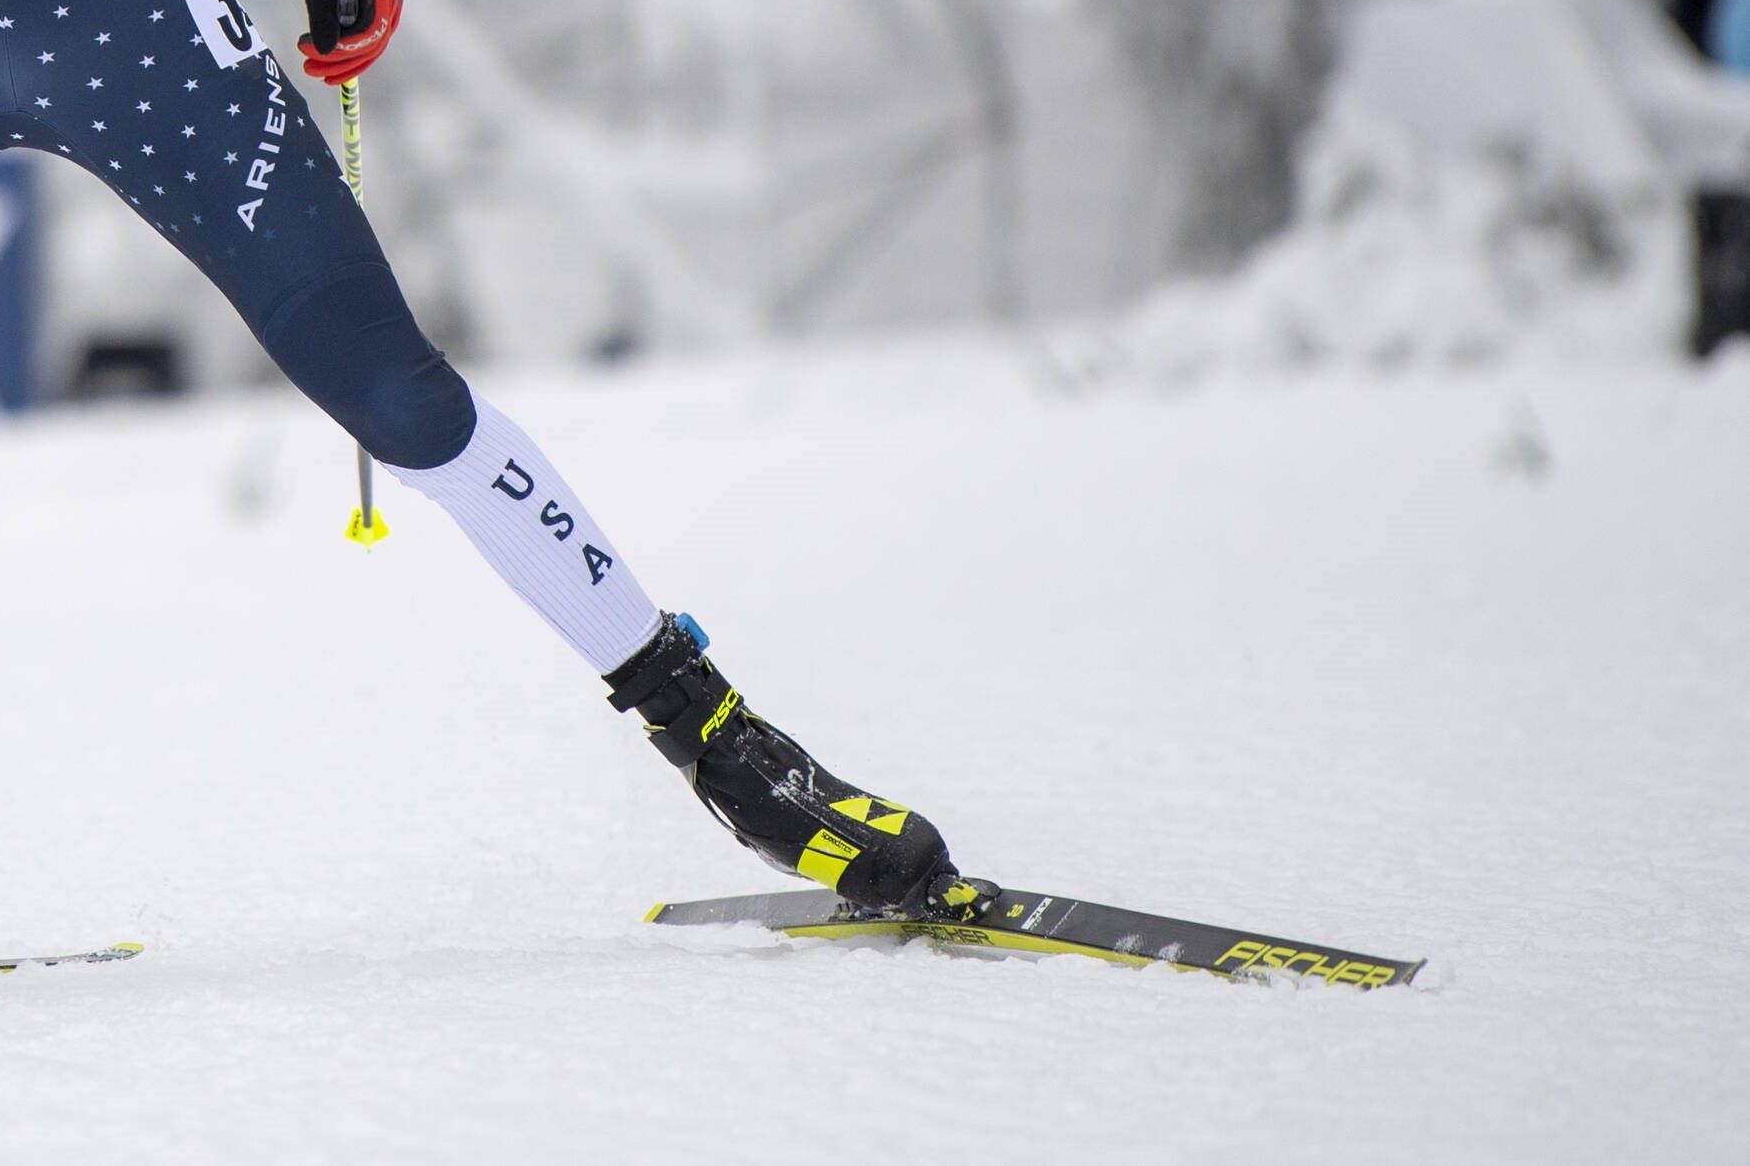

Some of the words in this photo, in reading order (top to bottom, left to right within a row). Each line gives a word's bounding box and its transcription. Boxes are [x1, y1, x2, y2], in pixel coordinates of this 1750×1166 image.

[236, 54, 287, 232] ARIENS
[491, 458, 613, 586] USA
[701, 688, 740, 743] FISC
[1214, 940, 1397, 989] FISCHER
